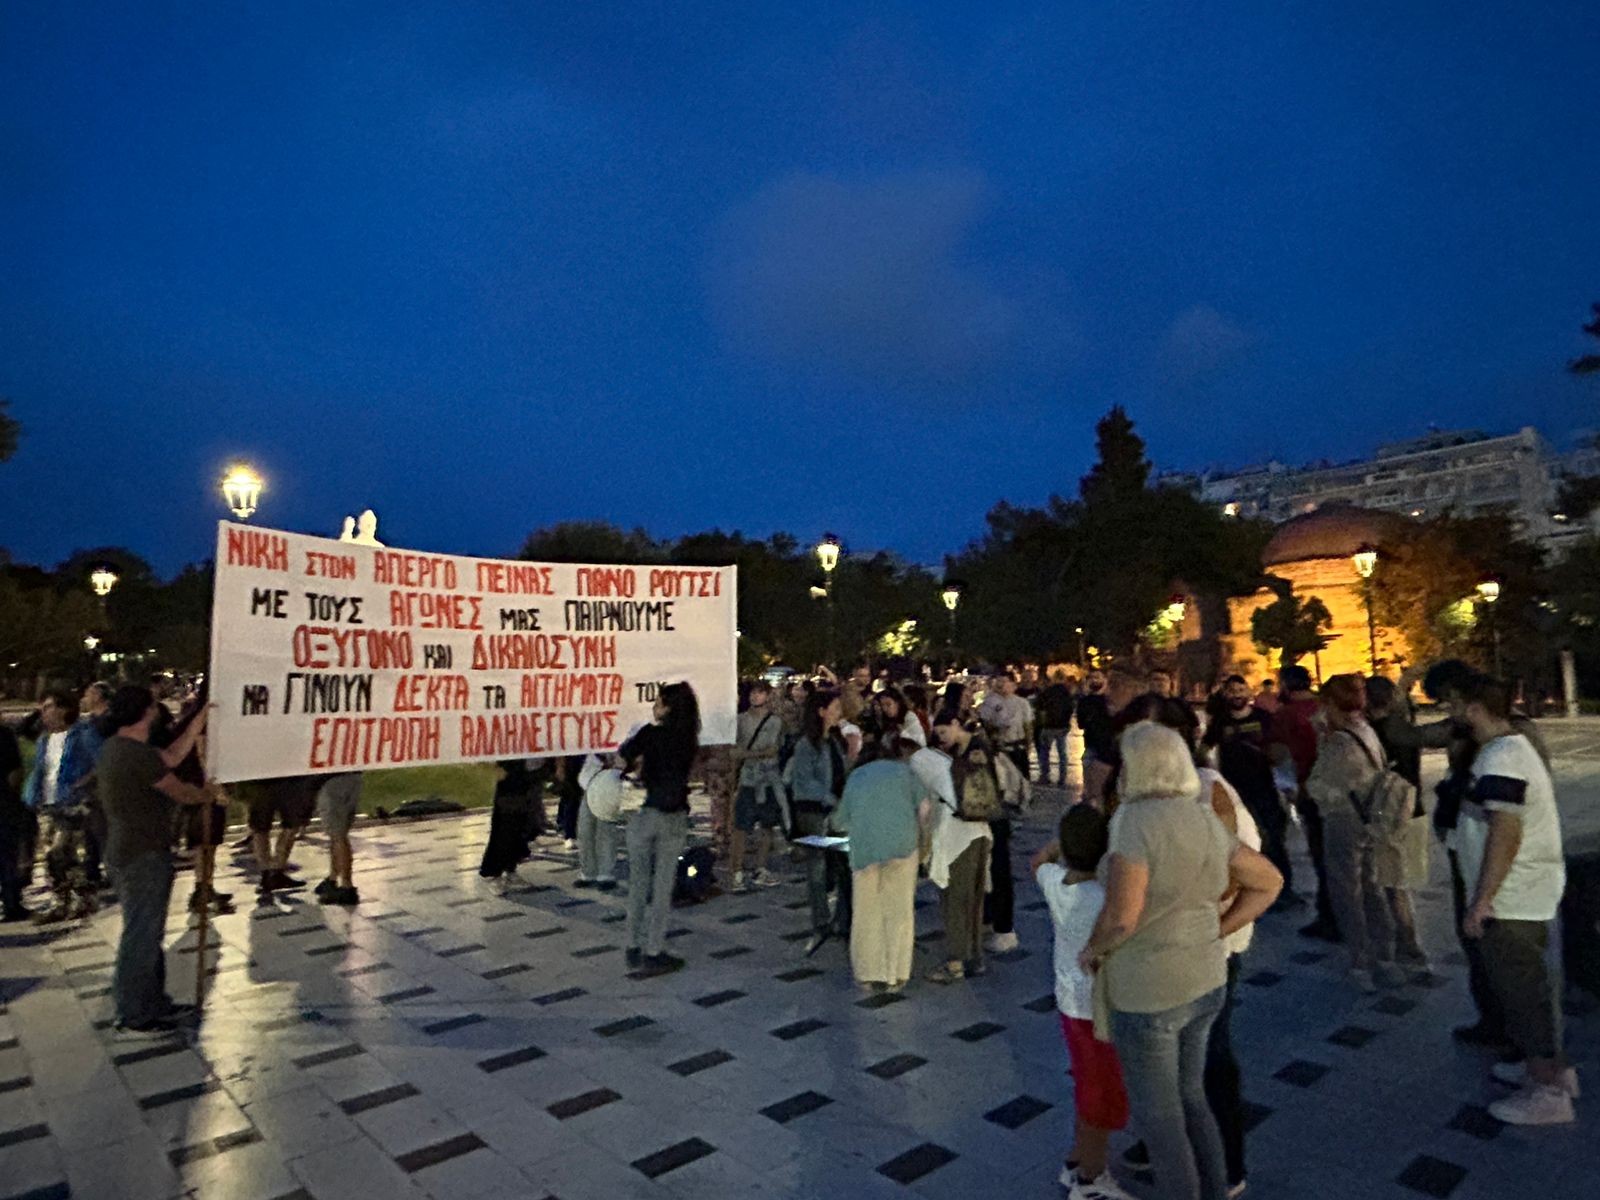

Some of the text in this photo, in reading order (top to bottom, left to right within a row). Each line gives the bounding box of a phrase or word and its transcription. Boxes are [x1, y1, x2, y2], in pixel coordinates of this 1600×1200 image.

[228, 528, 720, 598] ΝΙΚΗ ΣΤΟΝ ΑΠΕΡΓΟ ΠΕΙΝΑΣ ΠΑΝΟ ΡΟΥΤΣΙ
[251, 588, 675, 631] ΜΕ ΤΟΥΣ ΑΓΩΝΕΣ ΜΑΣ ΠΑΙΡΝΟΥΜΕ
[292, 625, 617, 670] ΟΞΥΓΟΝΟ ΚΑΙ ΔΙΚΑΙΟΣΥΝΗ
[242, 685, 269, 715] ΝΑ
[284, 673, 373, 714] ΓΙΝΟΥΝ
[393, 674, 470, 712] ΔΕΚΤΑ
[483, 685, 506, 709] ΤΑ
[520, 673, 624, 708] ΑΙΤΗΜΑΤΑ
[310, 711, 618, 768] ΕΠΙΤΡΟΠΗ ΑΛΛΗΛΕΓΓΥΗΣ
